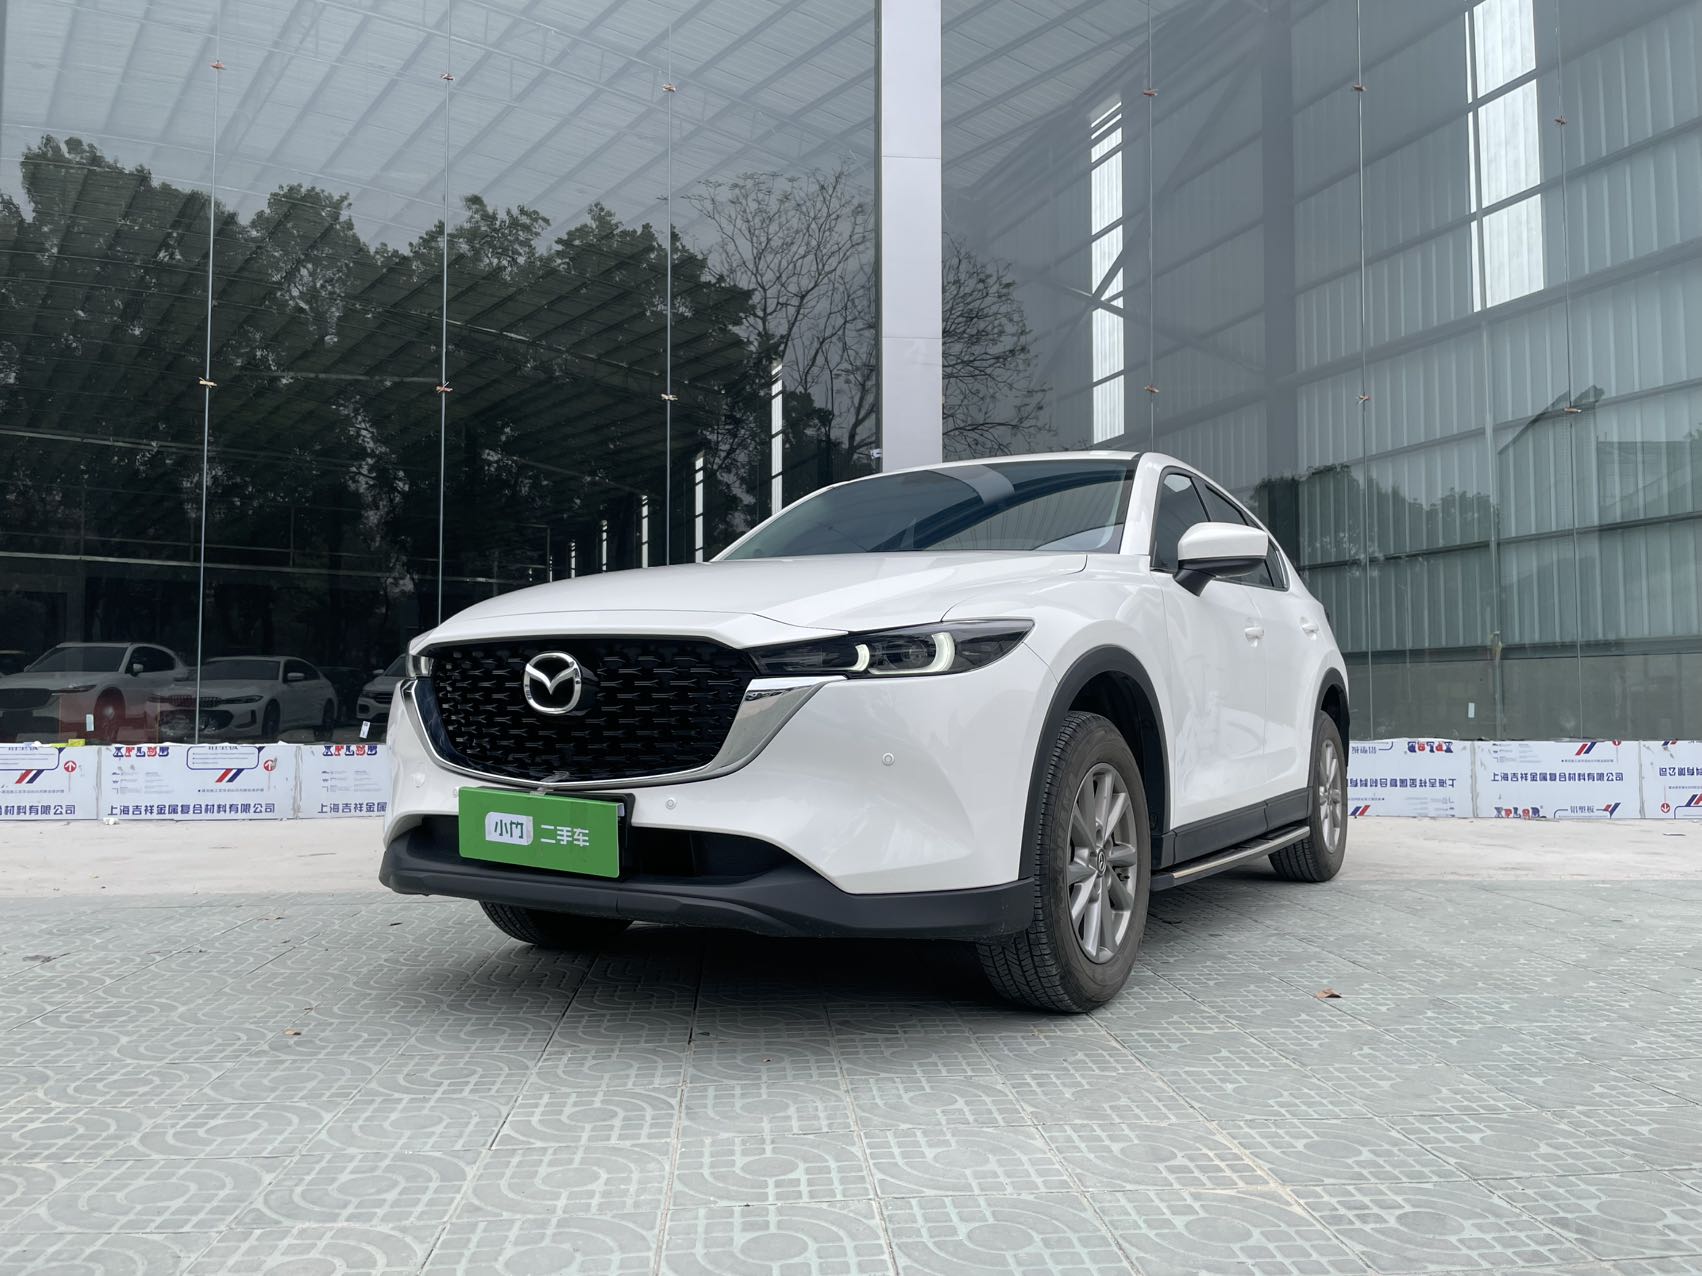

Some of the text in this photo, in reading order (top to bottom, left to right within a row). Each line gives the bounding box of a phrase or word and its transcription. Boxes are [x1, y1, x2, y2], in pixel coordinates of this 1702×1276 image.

[1346, 778, 1456, 788] 上海吉祥金属复合材料有
[1491, 772, 1624, 782] 上海吉祥金属复合材料有限公司
[0, 804, 76, 816] 材料有限公司
[108, 803, 276, 816] 上海吉祥金属复合材料有限公司
[494, 819, 590, 847] 小竹 二手车
